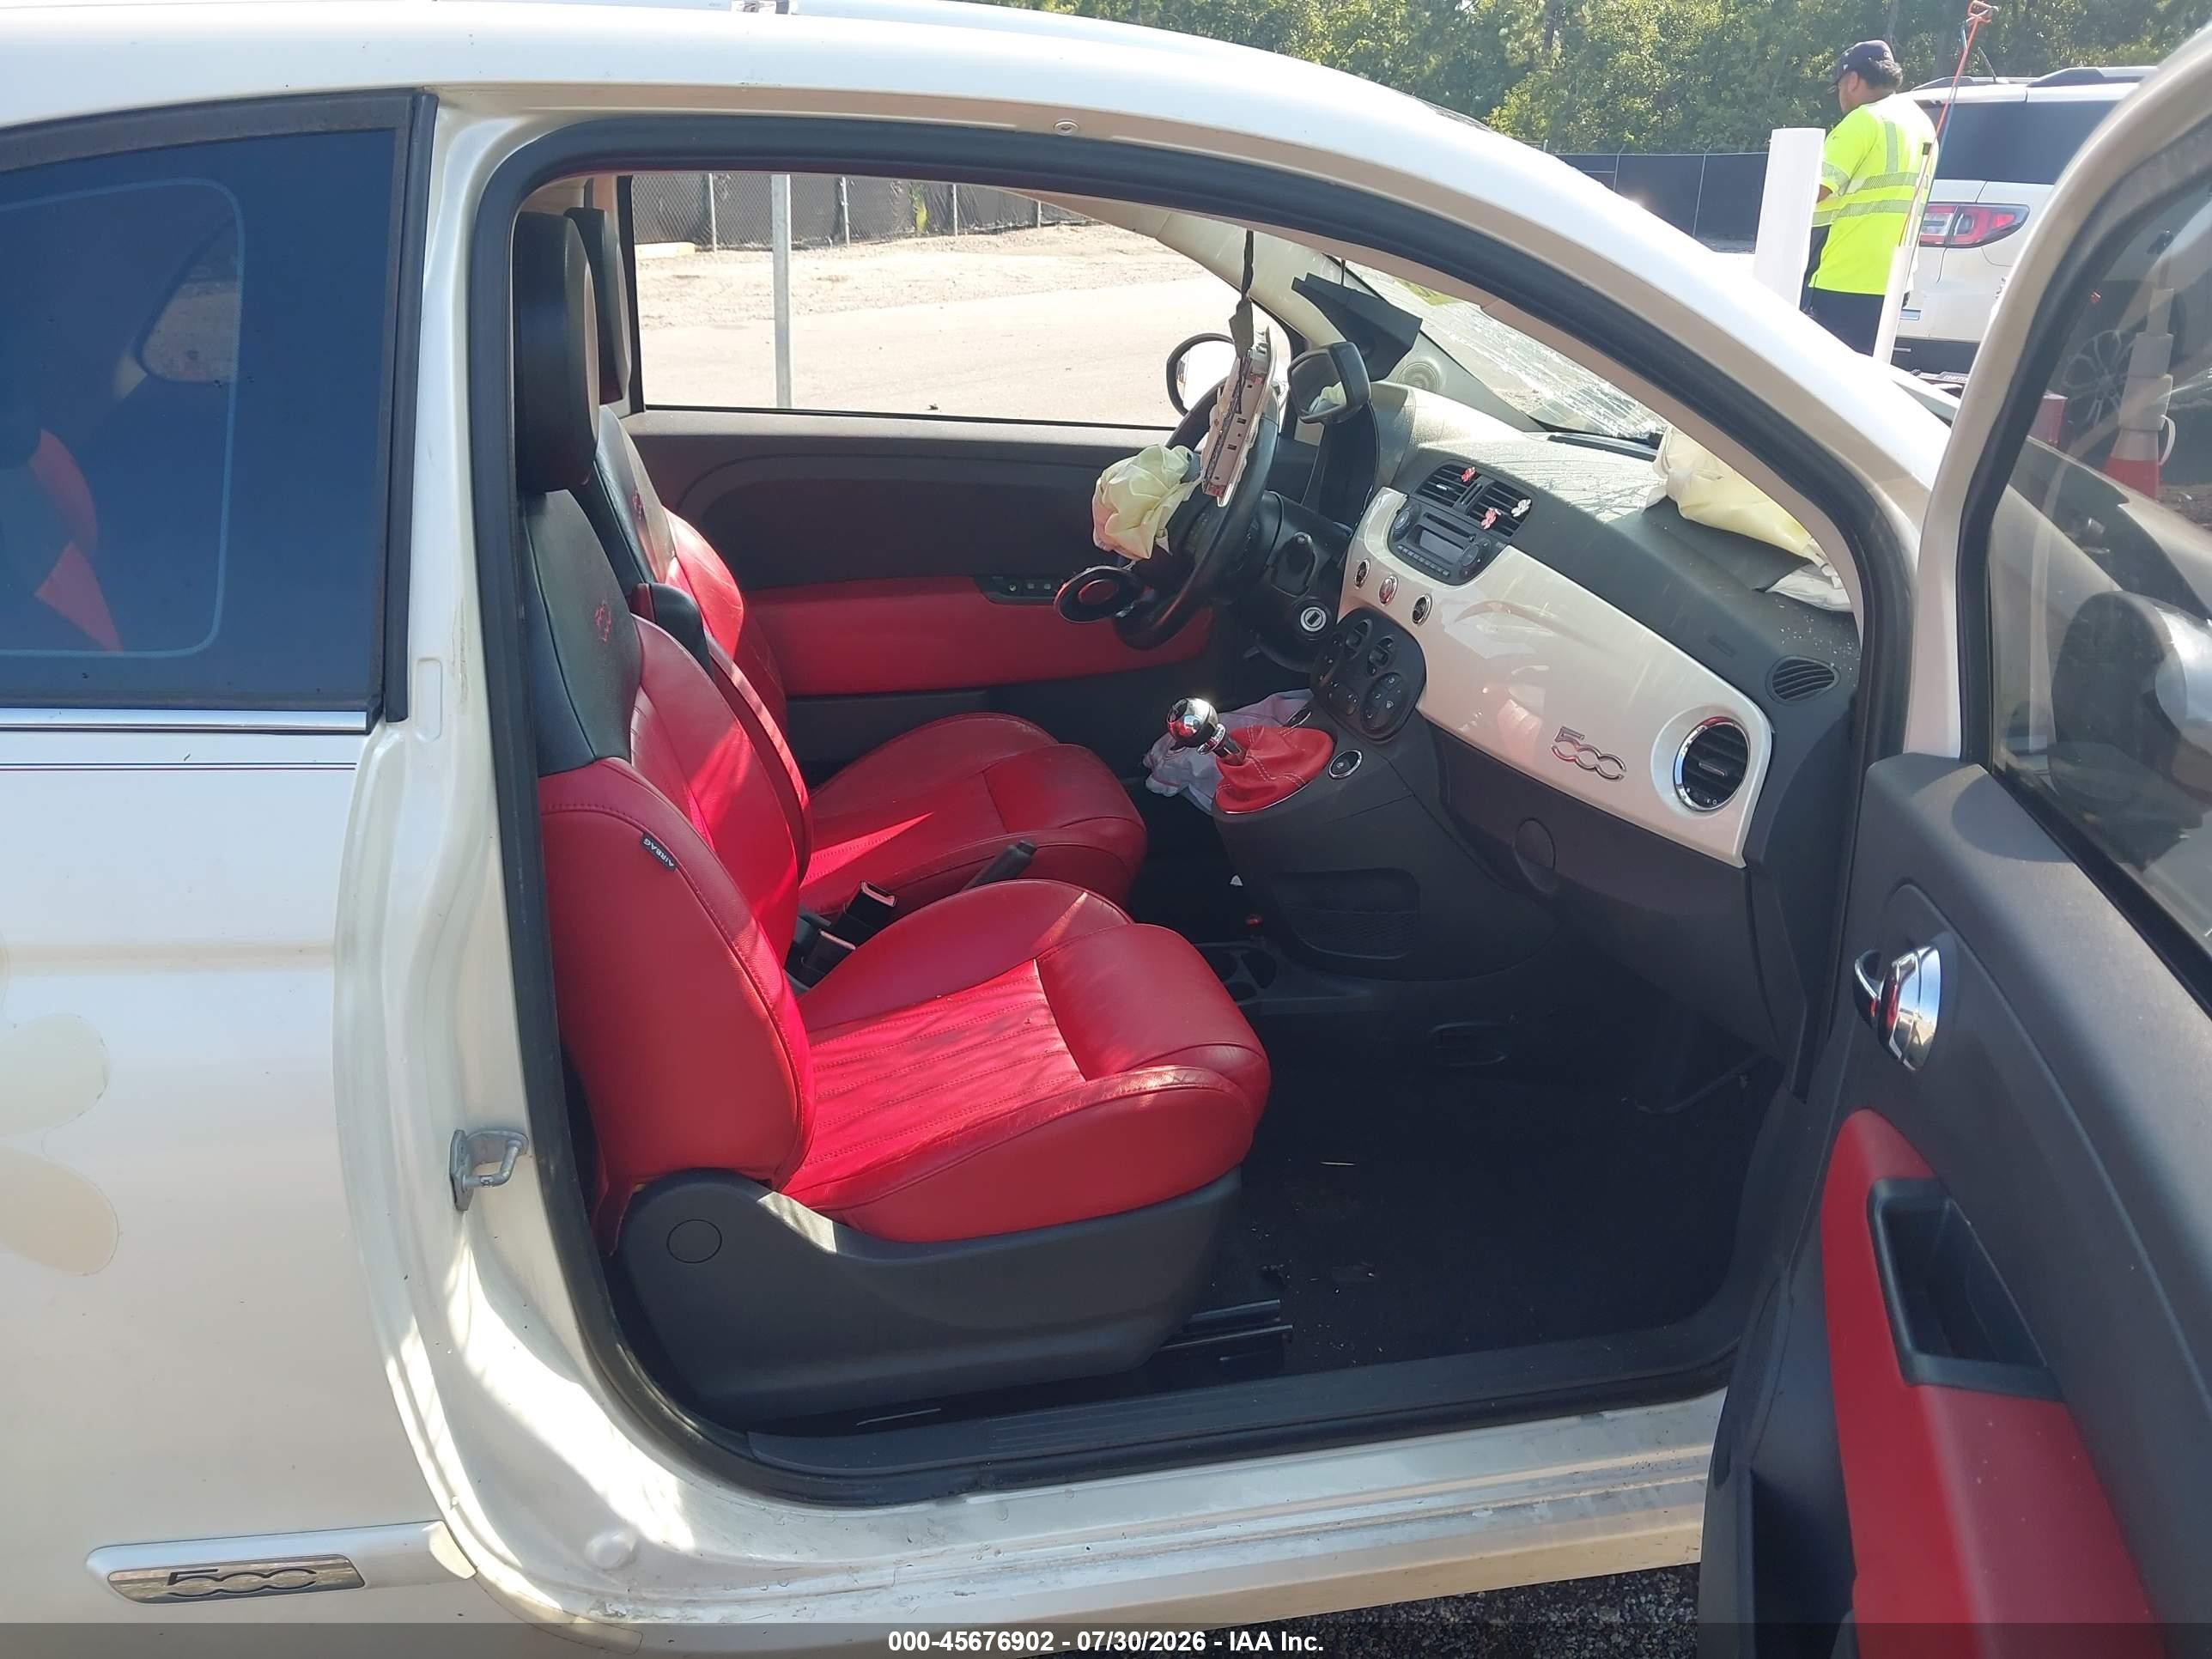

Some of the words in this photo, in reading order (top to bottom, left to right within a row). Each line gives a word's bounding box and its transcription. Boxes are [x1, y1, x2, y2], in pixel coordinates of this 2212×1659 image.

[1551, 726, 1626, 781] 500
[642, 837, 675, 866] AIRBAG
[166, 1567, 318, 1598] 500
